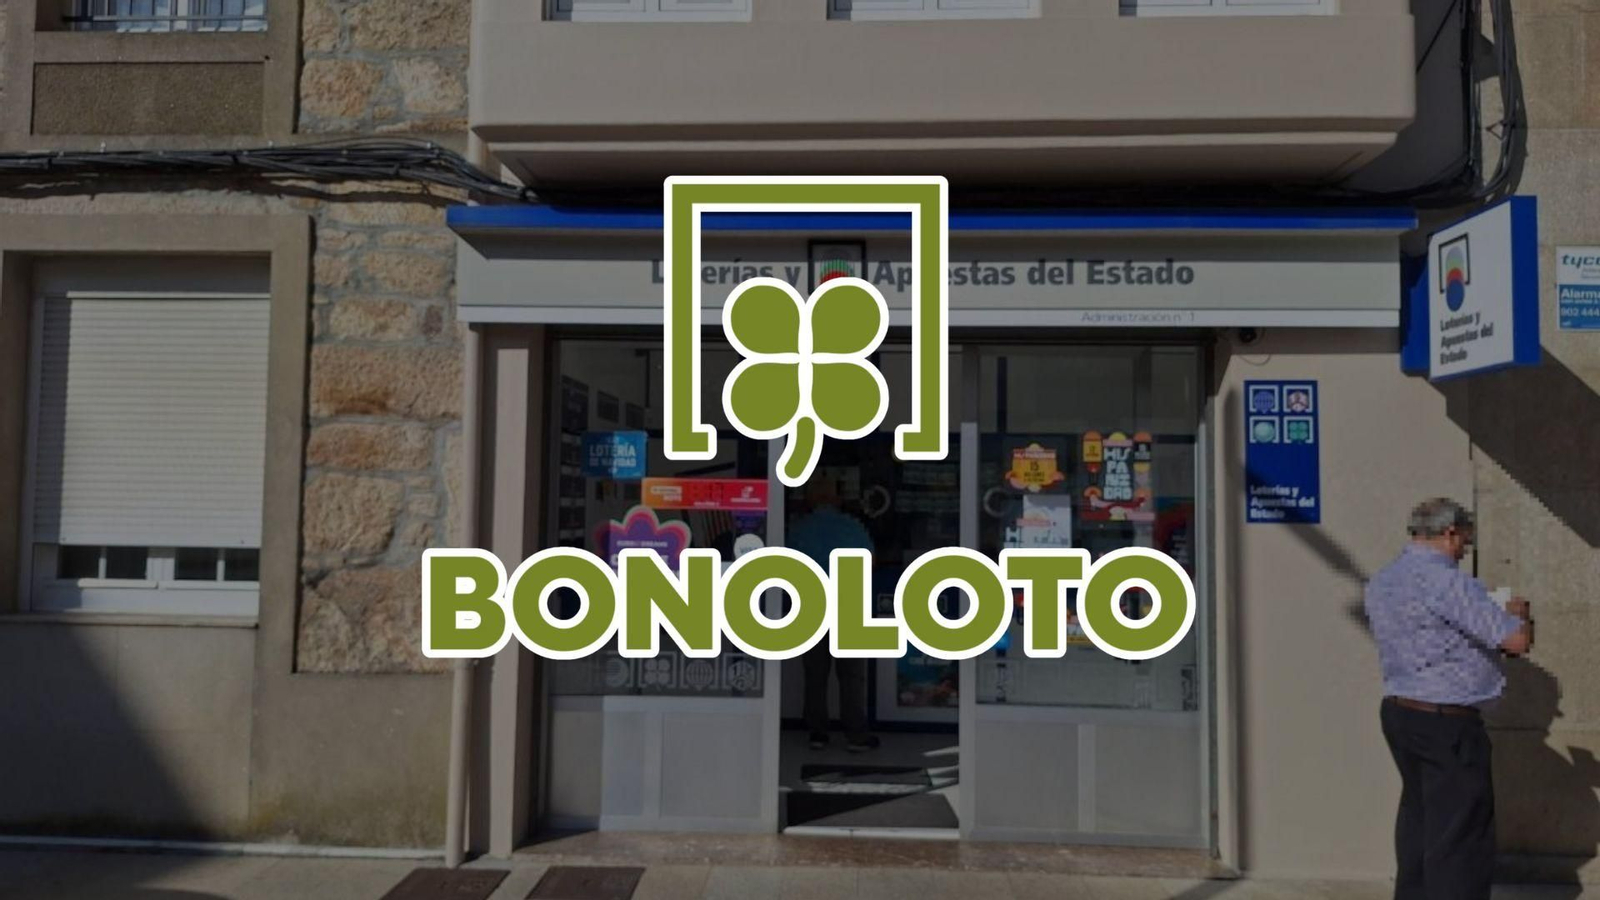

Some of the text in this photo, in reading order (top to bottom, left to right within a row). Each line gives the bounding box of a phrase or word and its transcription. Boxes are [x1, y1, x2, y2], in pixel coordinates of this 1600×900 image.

[651, 259, 774, 285] Lerías
[873, 259, 1016, 292] Apstas
[1027, 258, 1075, 285] del
[1087, 258, 1195, 285] Estado
[1081, 310, 1169, 323] Administración
[1475, 312, 1481, 325] y
[1440, 322, 1493, 349] Apuestas del
[1440, 347, 1467, 366] Estado
[1291, 486, 1299, 497] y
[1250, 496, 1315, 509] Apuestas del
[1250, 508, 1285, 519] Estado
